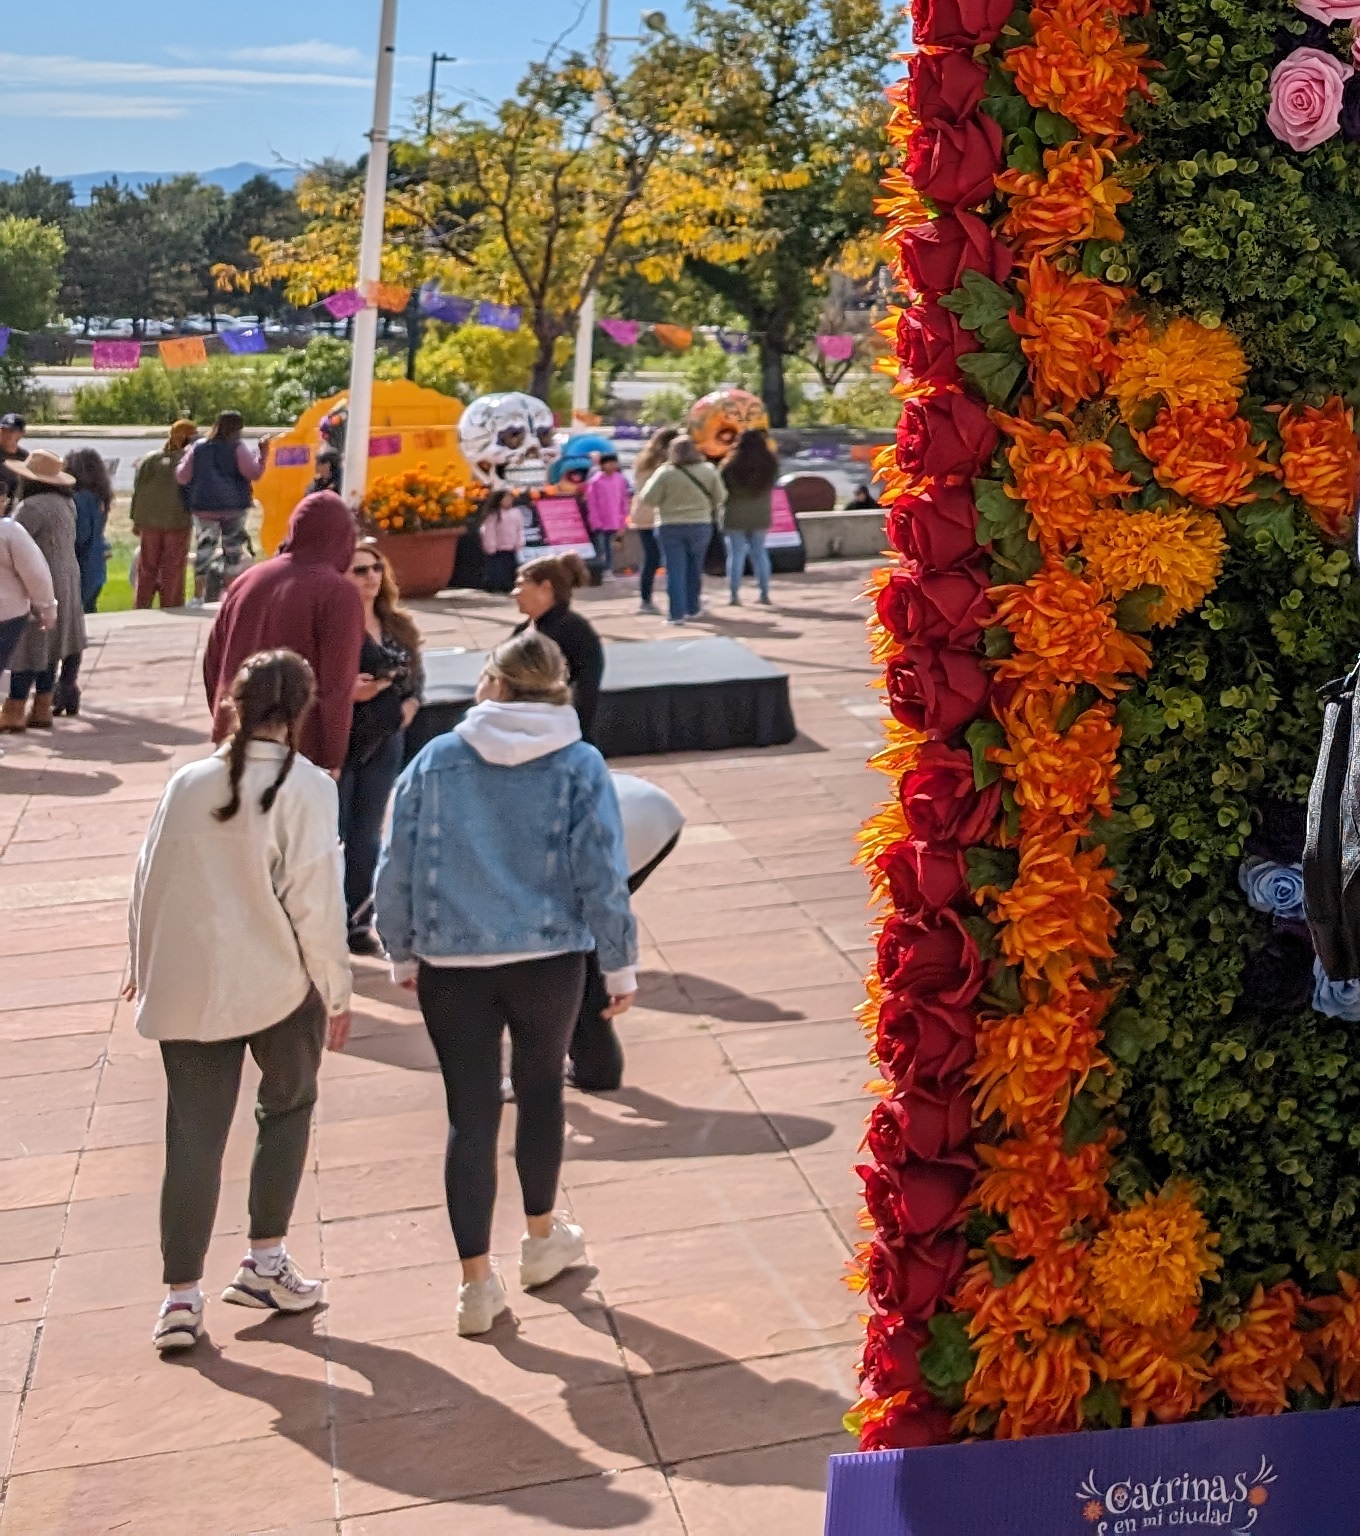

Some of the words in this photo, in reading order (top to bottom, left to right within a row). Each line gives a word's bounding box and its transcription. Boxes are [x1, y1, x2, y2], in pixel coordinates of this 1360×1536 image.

[1105, 1471, 1248, 1514] Catrinas
[1114, 1517, 1137, 1535] en
[1143, 1508, 1163, 1528] mi
[1168, 1499, 1234, 1526] ciudad
